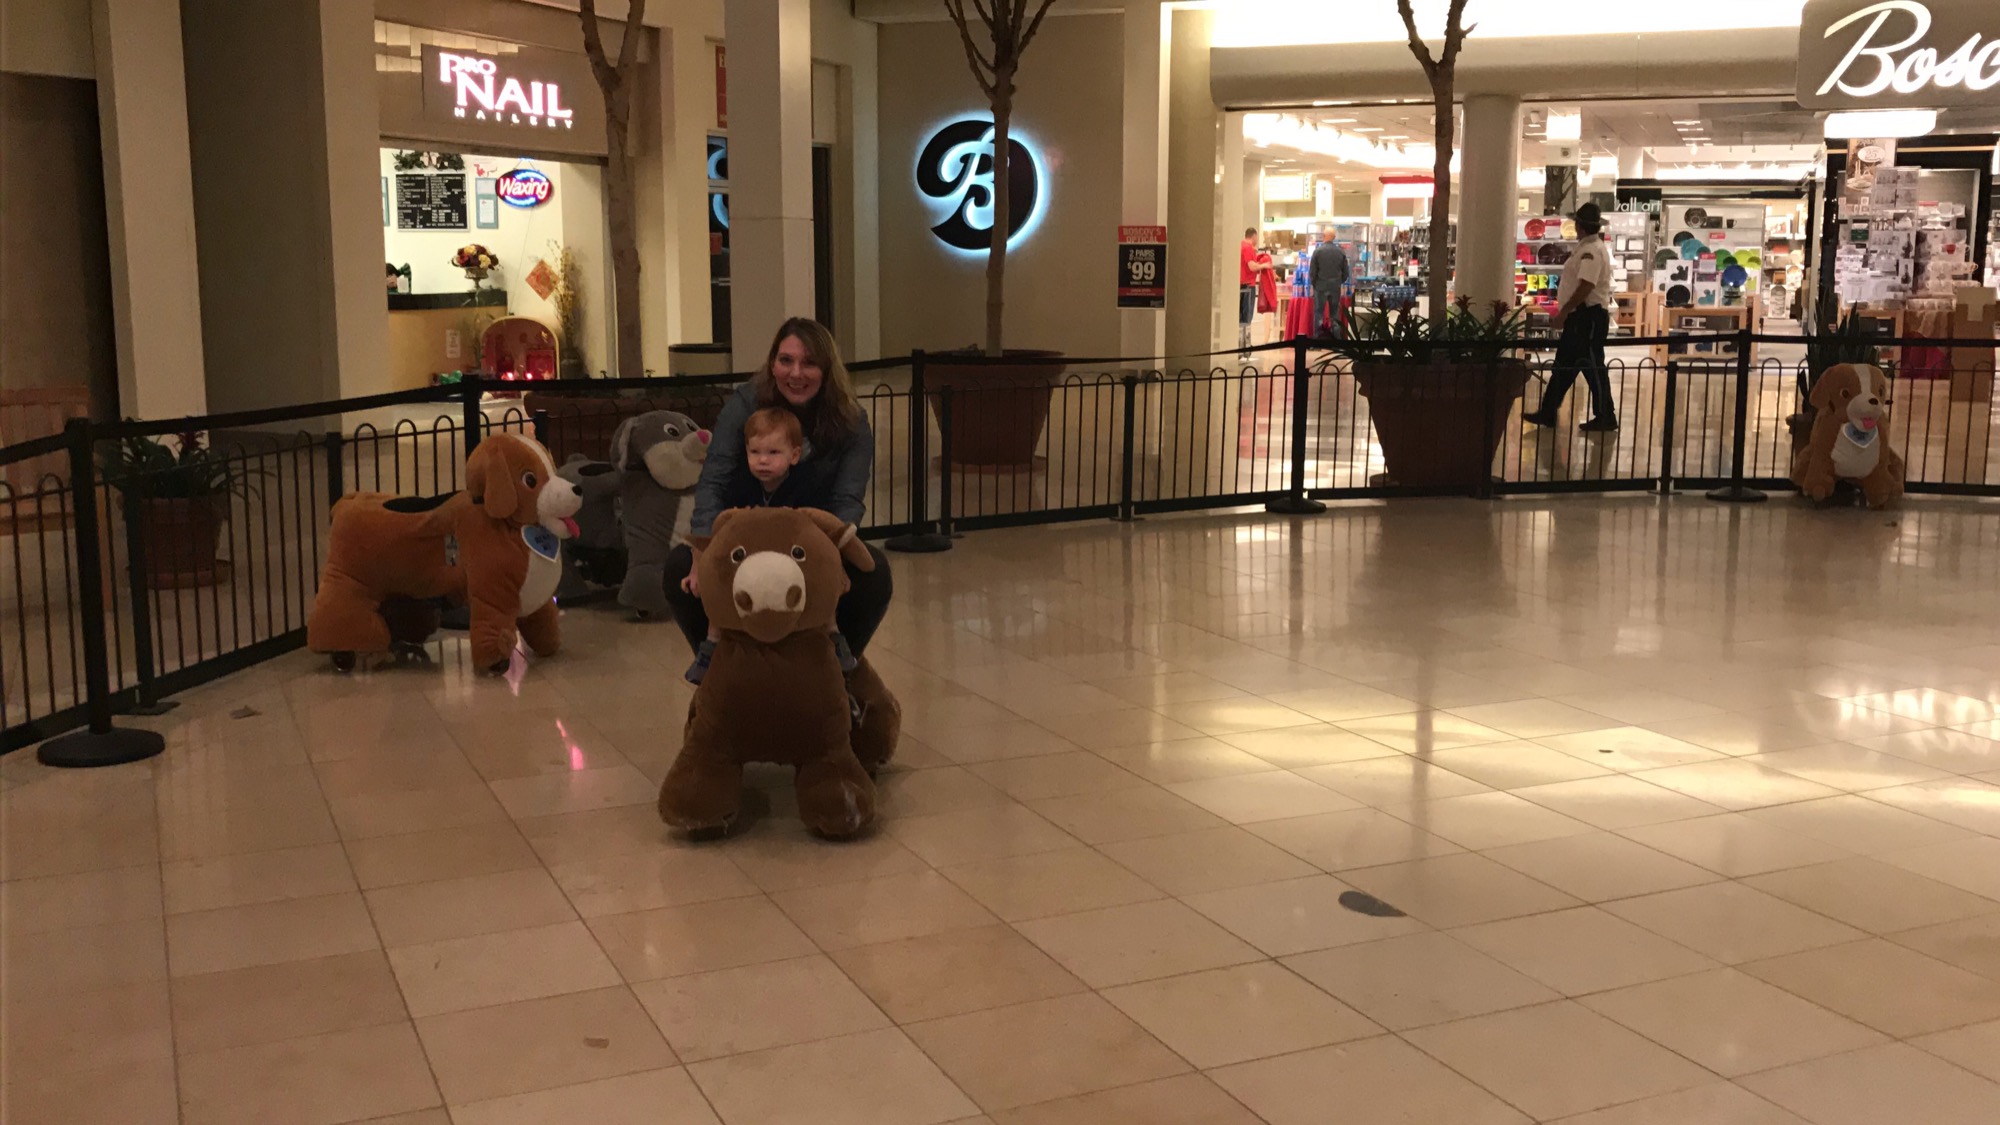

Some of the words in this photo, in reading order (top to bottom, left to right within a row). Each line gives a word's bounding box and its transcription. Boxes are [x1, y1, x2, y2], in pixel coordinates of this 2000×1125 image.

[439, 52, 497, 83] PRO
[456, 71, 573, 119] NAIL
[499, 177, 549, 200] Waxing
[1126, 235, 1158, 243] OPTICAL
[1135, 249, 1155, 257] PAIRS
